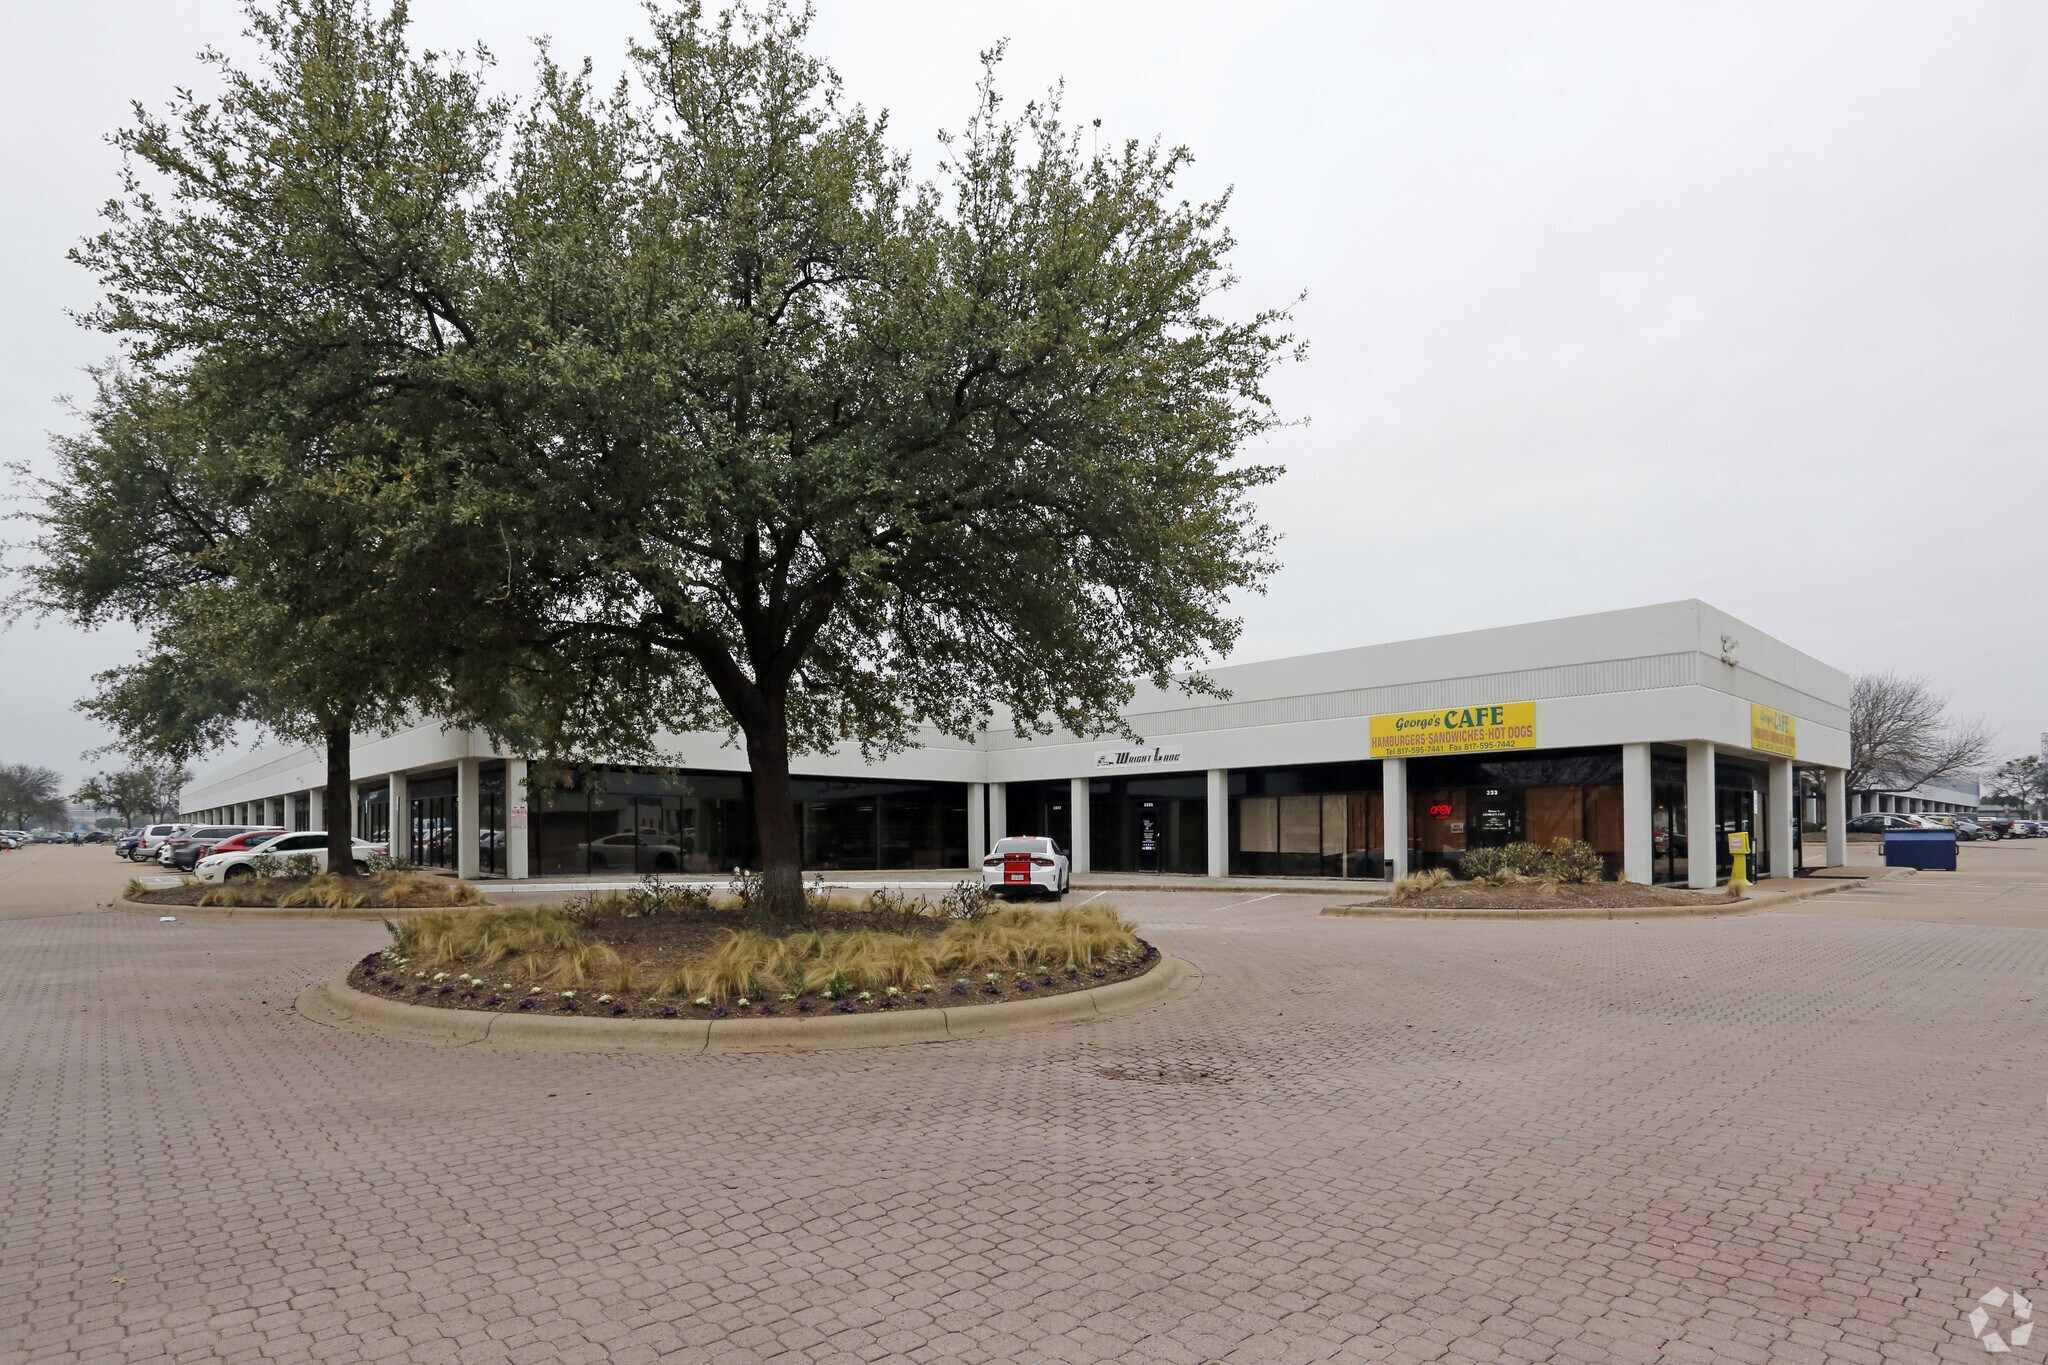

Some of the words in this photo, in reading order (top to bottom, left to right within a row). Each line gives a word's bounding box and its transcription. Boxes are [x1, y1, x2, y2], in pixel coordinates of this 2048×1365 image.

[1396, 714, 1440, 731] George's
[1444, 706, 1504, 729] CAFE
[1507, 725, 1533, 738] DOGS
[1397, 745, 1444, 755] 817-595-7441
[1449, 743, 1462, 751] Fax
[1464, 740, 1516, 750] 817-595-7442
[1430, 805, 1452, 815] OPEN
